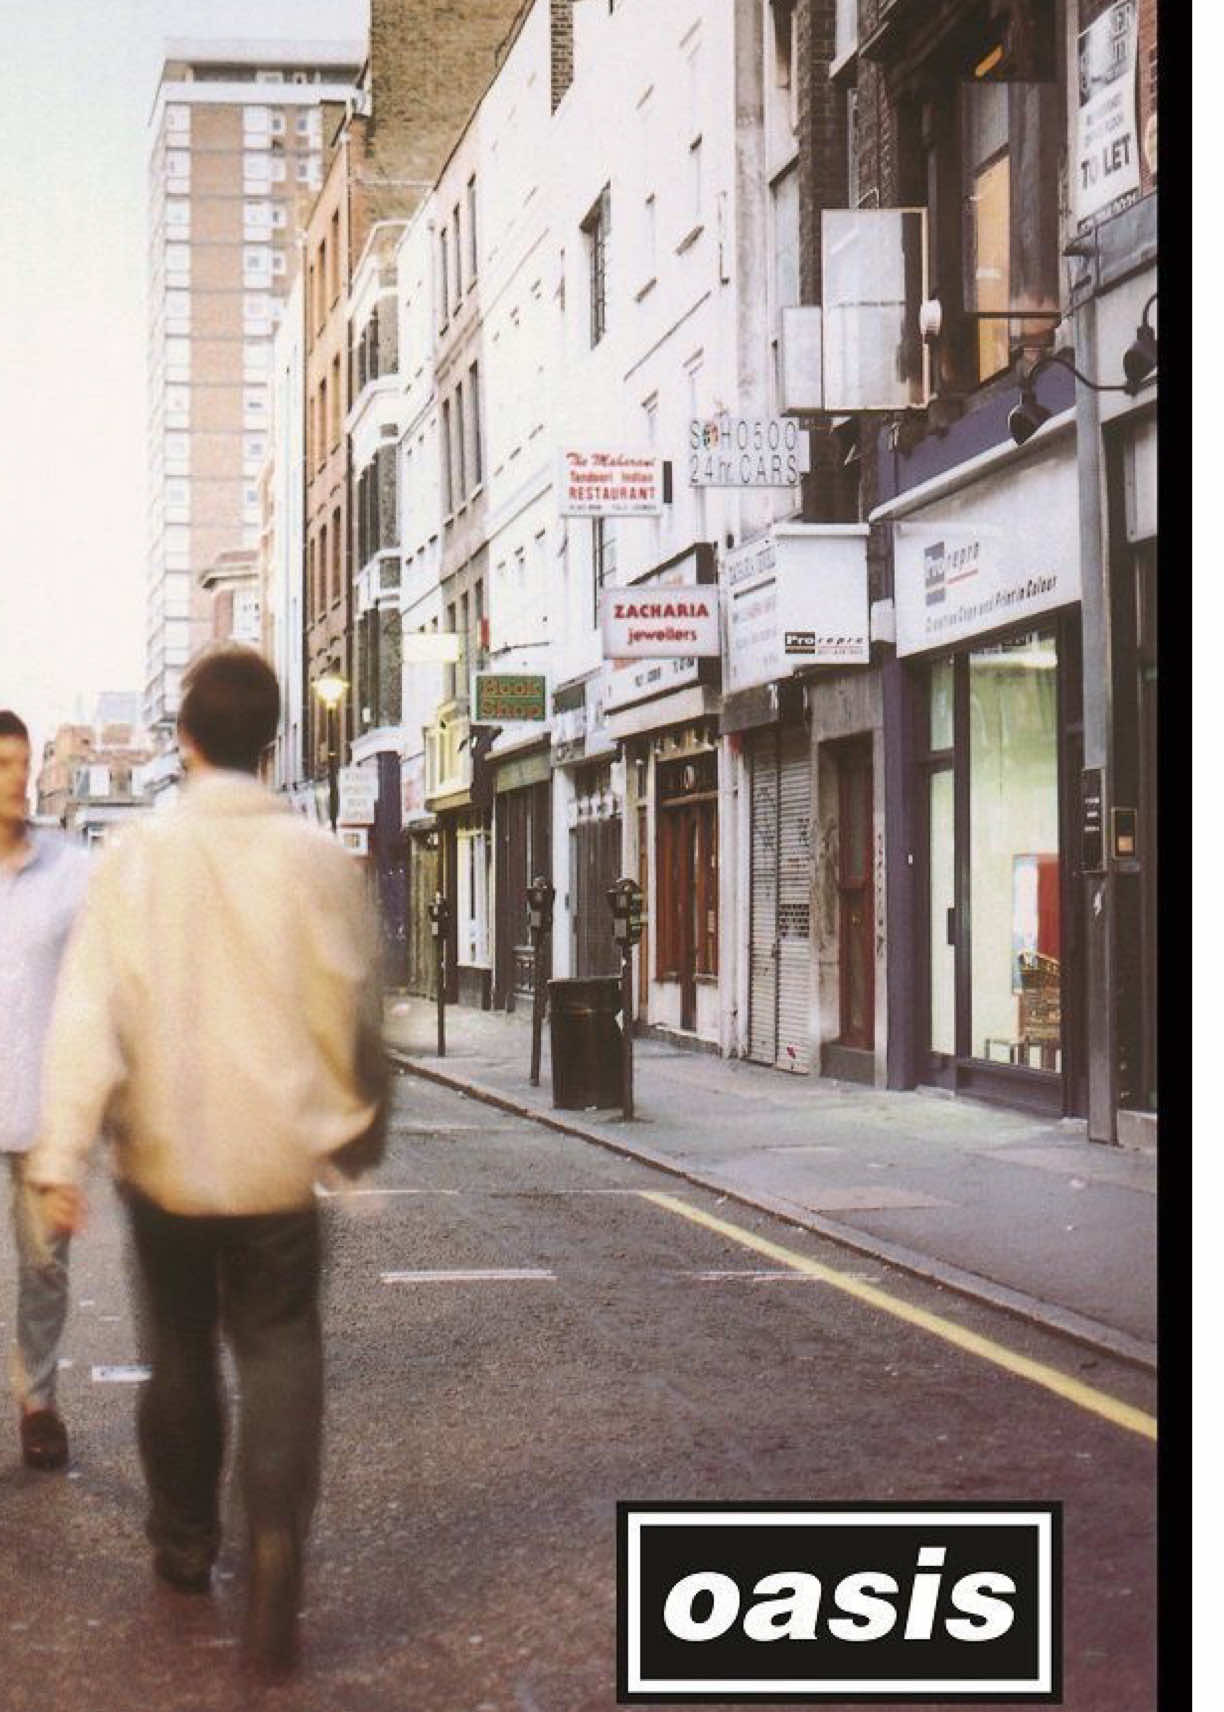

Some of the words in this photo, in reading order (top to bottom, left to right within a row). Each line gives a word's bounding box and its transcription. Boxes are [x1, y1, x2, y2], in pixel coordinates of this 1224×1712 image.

[1104, 132, 1131, 176] LET
[740, 453, 798, 484] CARS
[568, 486, 656, 500] RESTAURANT
[614, 603, 709, 619] ZACHARIA
[626, 627, 697, 646] jewellers
